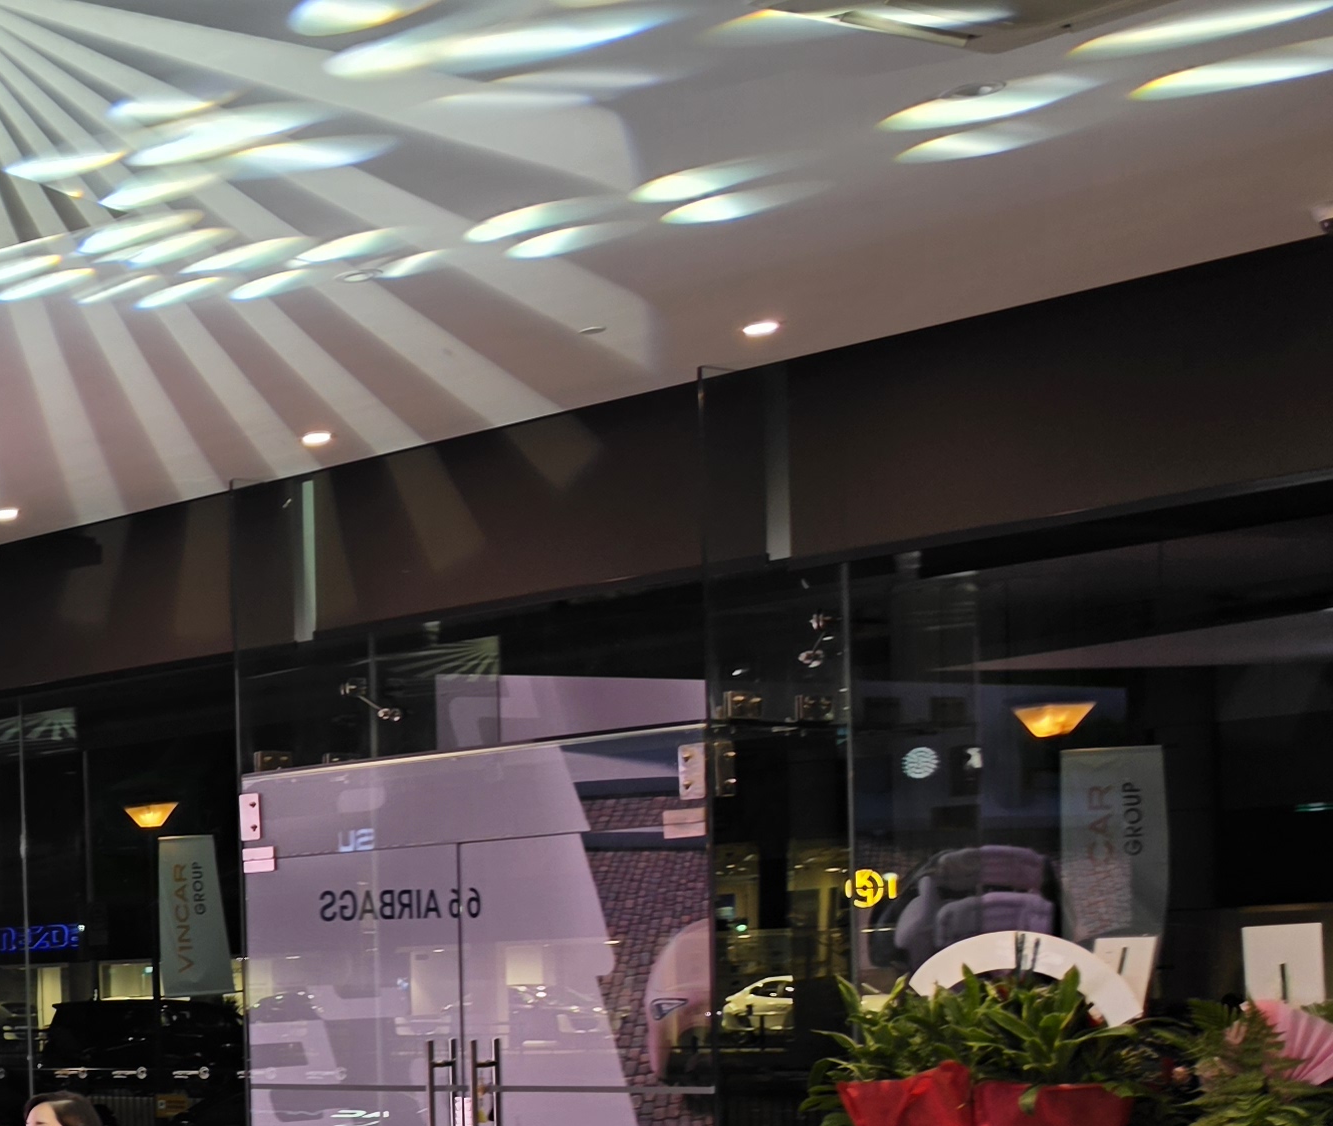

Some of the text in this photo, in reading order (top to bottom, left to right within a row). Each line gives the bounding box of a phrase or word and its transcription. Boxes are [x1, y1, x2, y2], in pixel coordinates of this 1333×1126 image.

[1121, 781, 1144, 856] GROUP
[172, 863, 195, 973] VINCAR
[191, 861, 206, 915] GROUP
